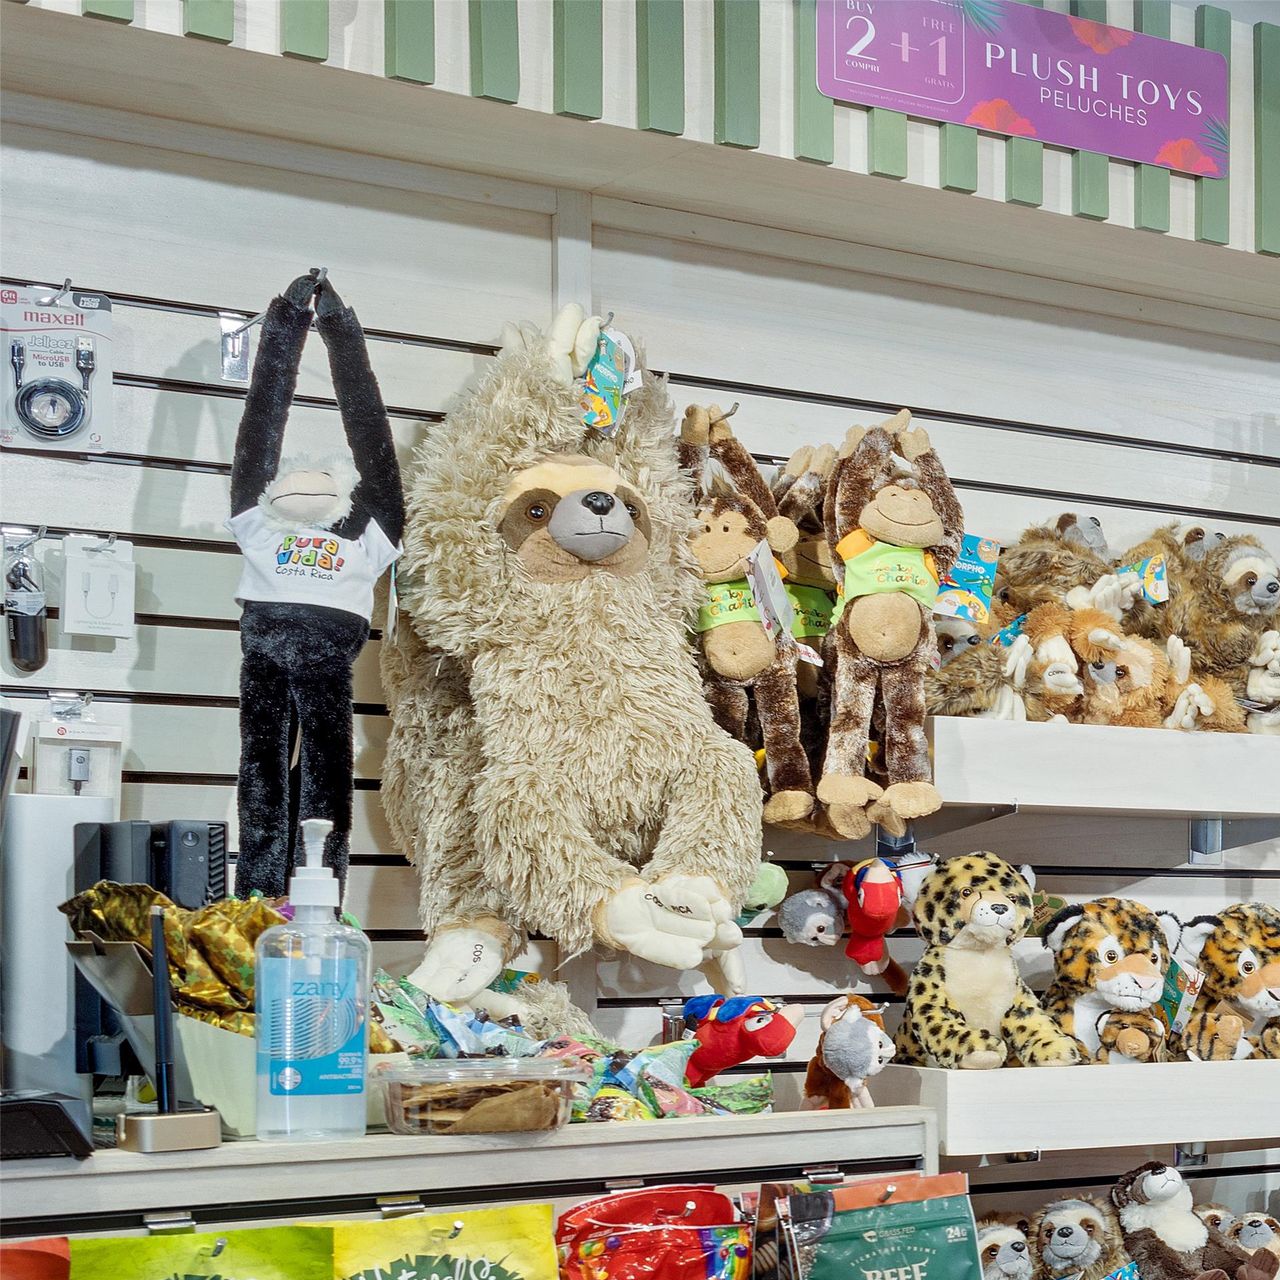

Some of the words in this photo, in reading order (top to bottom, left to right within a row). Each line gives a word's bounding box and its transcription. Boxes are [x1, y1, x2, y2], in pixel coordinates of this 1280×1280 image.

[984, 42, 1099, 93] PLUSH
[1116, 71, 1203, 117] TOYS
[1039, 86, 1148, 127] PELUCHES
[24, 311, 84, 327] maxell
[28, 335, 74, 349] Jelleez
[33, 354, 70, 363] MicroUSB
[275, 566, 306, 576] Costa
[311, 568, 334, 580] Rica
[292, 981, 350, 1001] zany
